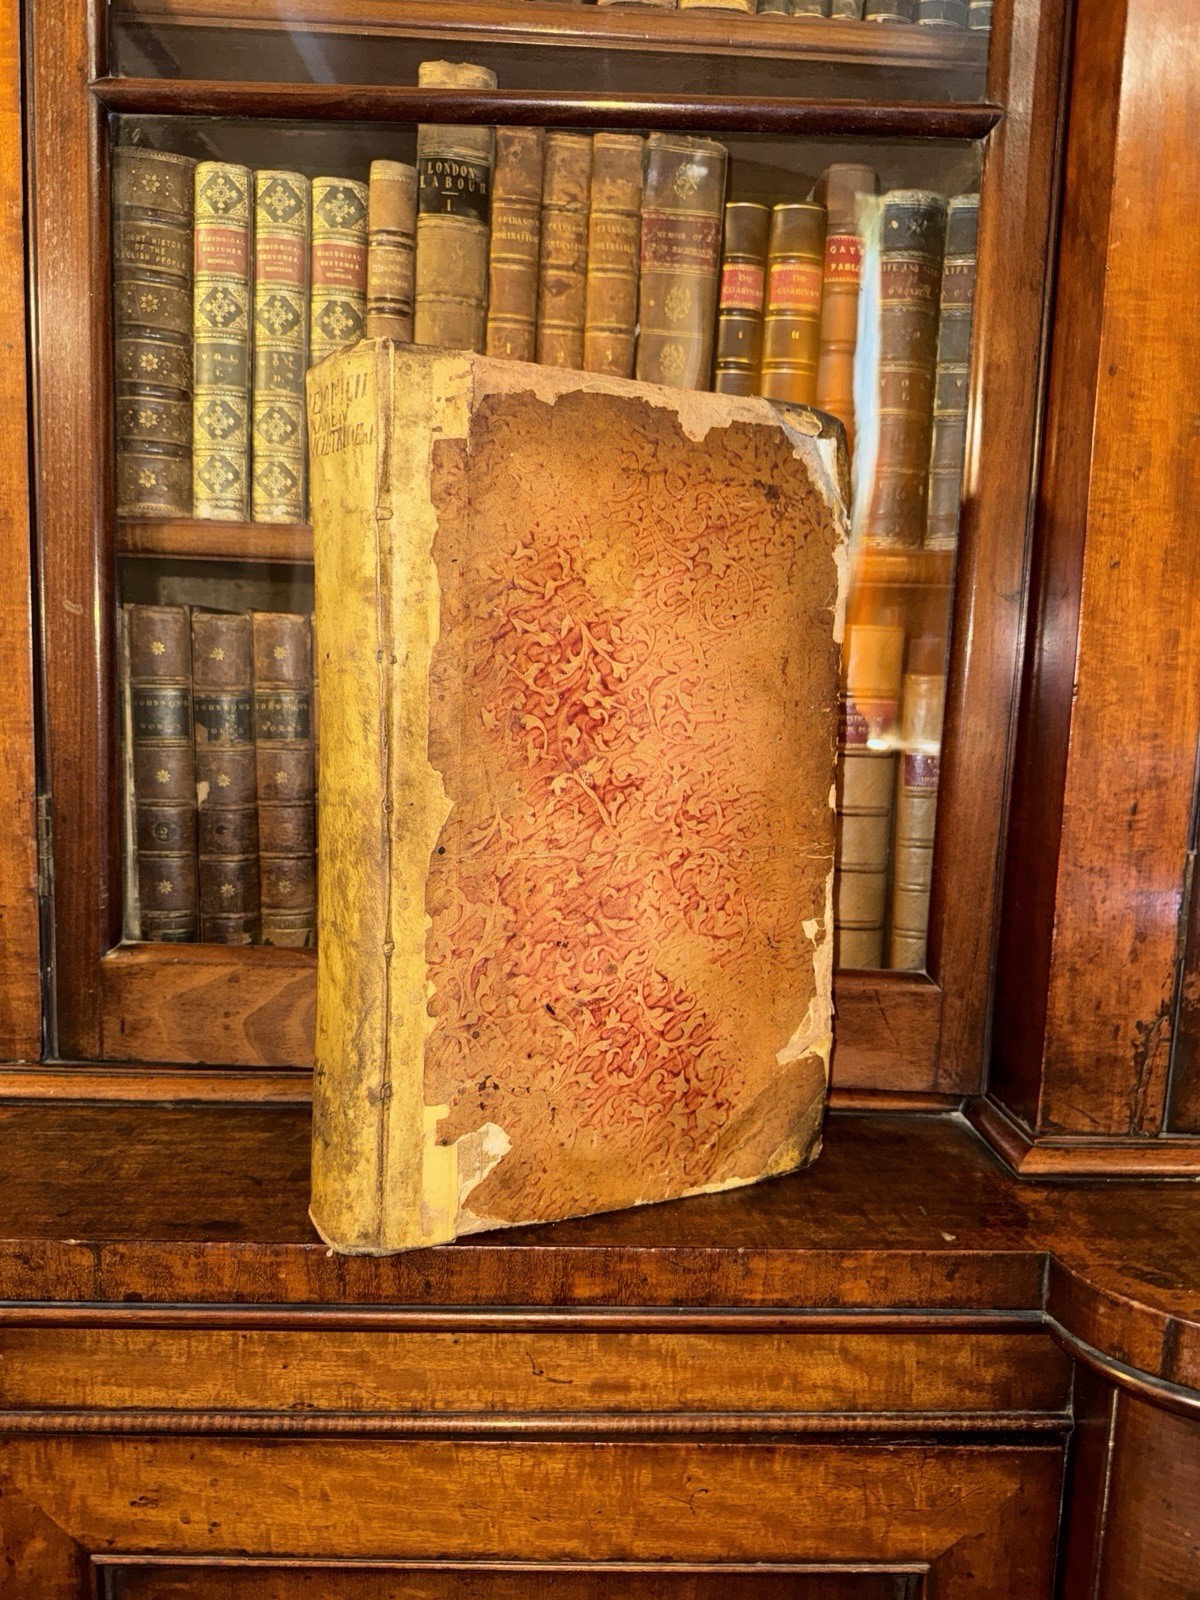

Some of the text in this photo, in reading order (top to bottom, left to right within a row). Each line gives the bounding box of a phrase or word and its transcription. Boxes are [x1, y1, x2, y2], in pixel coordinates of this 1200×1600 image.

[427, 161, 475, 179] LONDON
[420, 175, 486, 195] LABOUR
[134, 243, 166, 256] OF THE
[151, 236, 187, 251] HISTORY
[116, 250, 186, 270] ENGLISH PEOPLE
